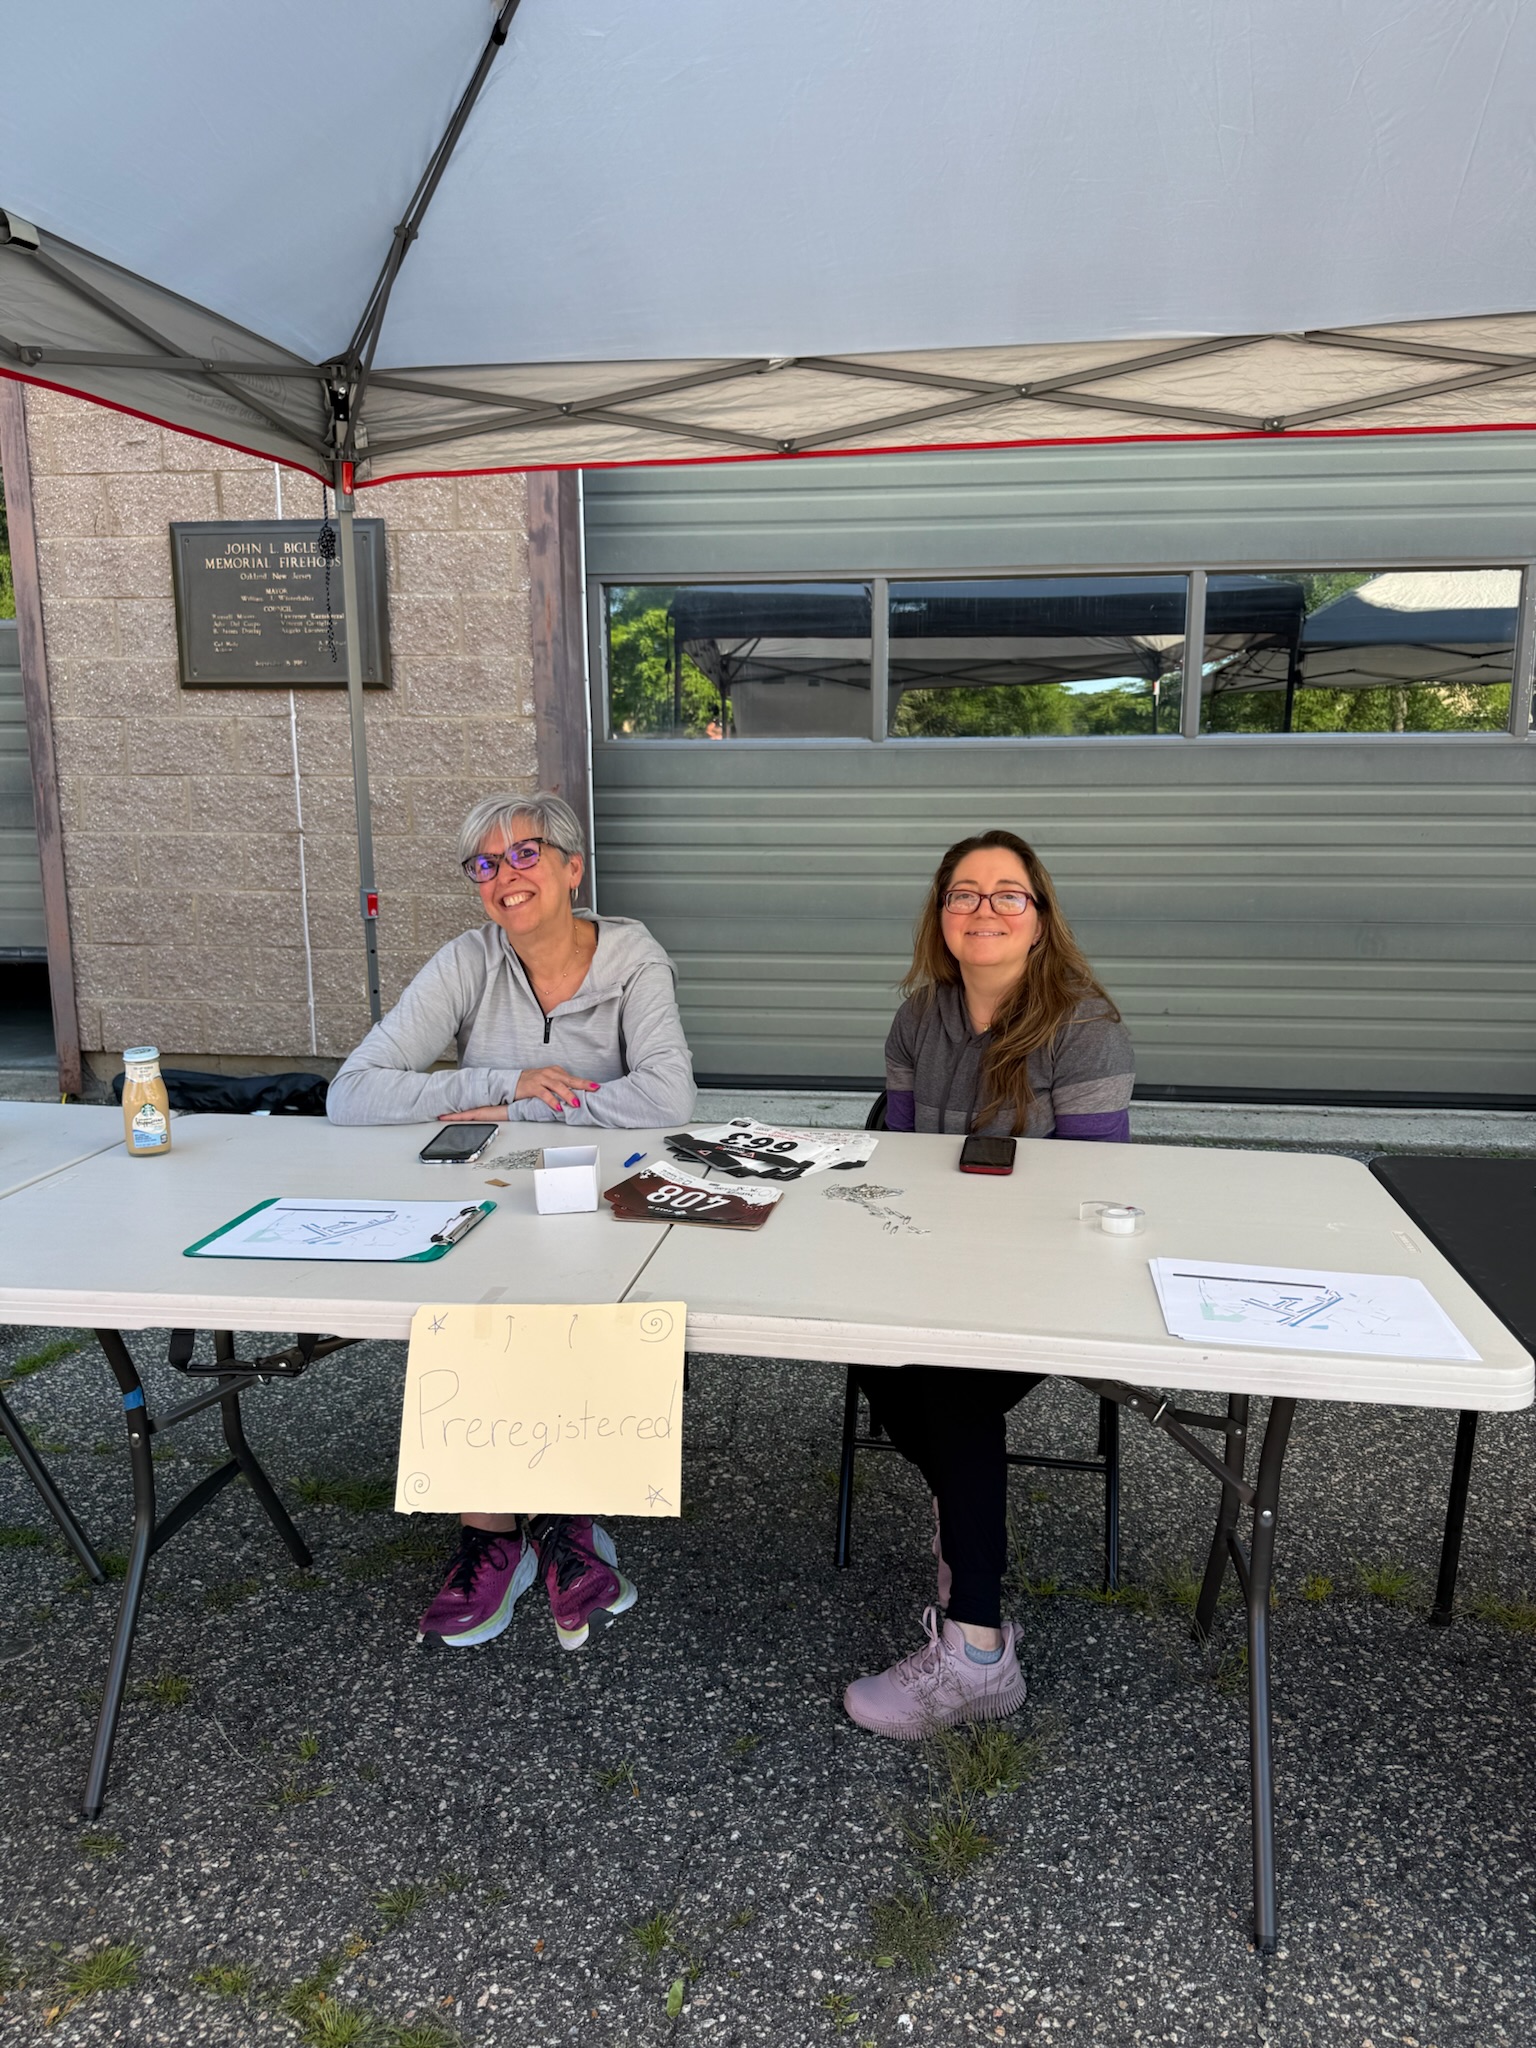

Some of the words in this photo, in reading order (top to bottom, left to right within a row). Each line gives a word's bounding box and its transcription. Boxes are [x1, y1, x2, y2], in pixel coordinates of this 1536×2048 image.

[224, 542, 262, 555] JOHN
[269, 542, 279, 555] L.
[284, 541, 322, 555] BIGLE
[204, 557, 272, 570] MEMORIAL
[271, 572, 287, 580] New
[265, 587, 288, 595] MAYOR
[719, 1132, 798, 1153] 663
[646, 1184, 731, 1212] 408
[418, 1368, 678, 1470] Preregistered
